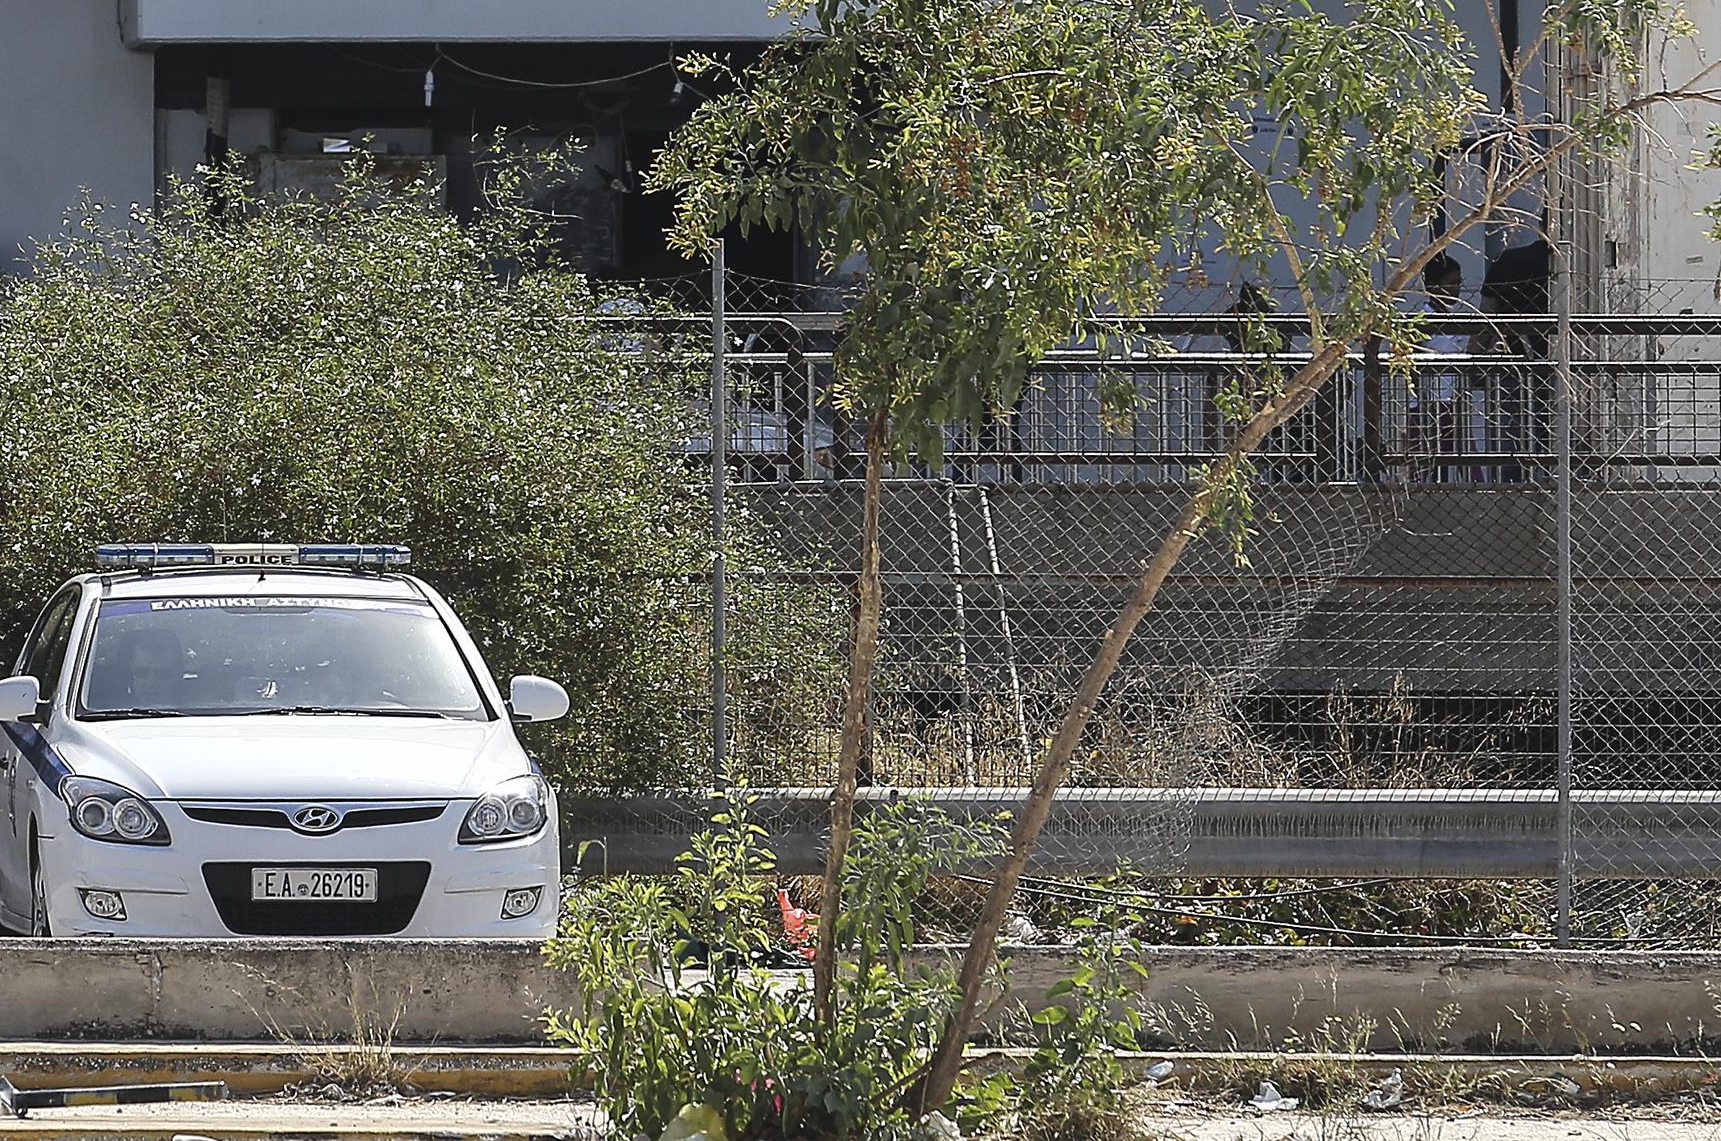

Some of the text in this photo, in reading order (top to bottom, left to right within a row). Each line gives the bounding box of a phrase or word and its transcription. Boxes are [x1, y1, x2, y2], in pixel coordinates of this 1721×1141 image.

[221, 555, 293, 565] POLICE
[151, 597, 386, 611] ΕΛΛΗΝΙΚΗ ΑΣΤΥΝΟ
[310, 872, 365, 898] 26219
